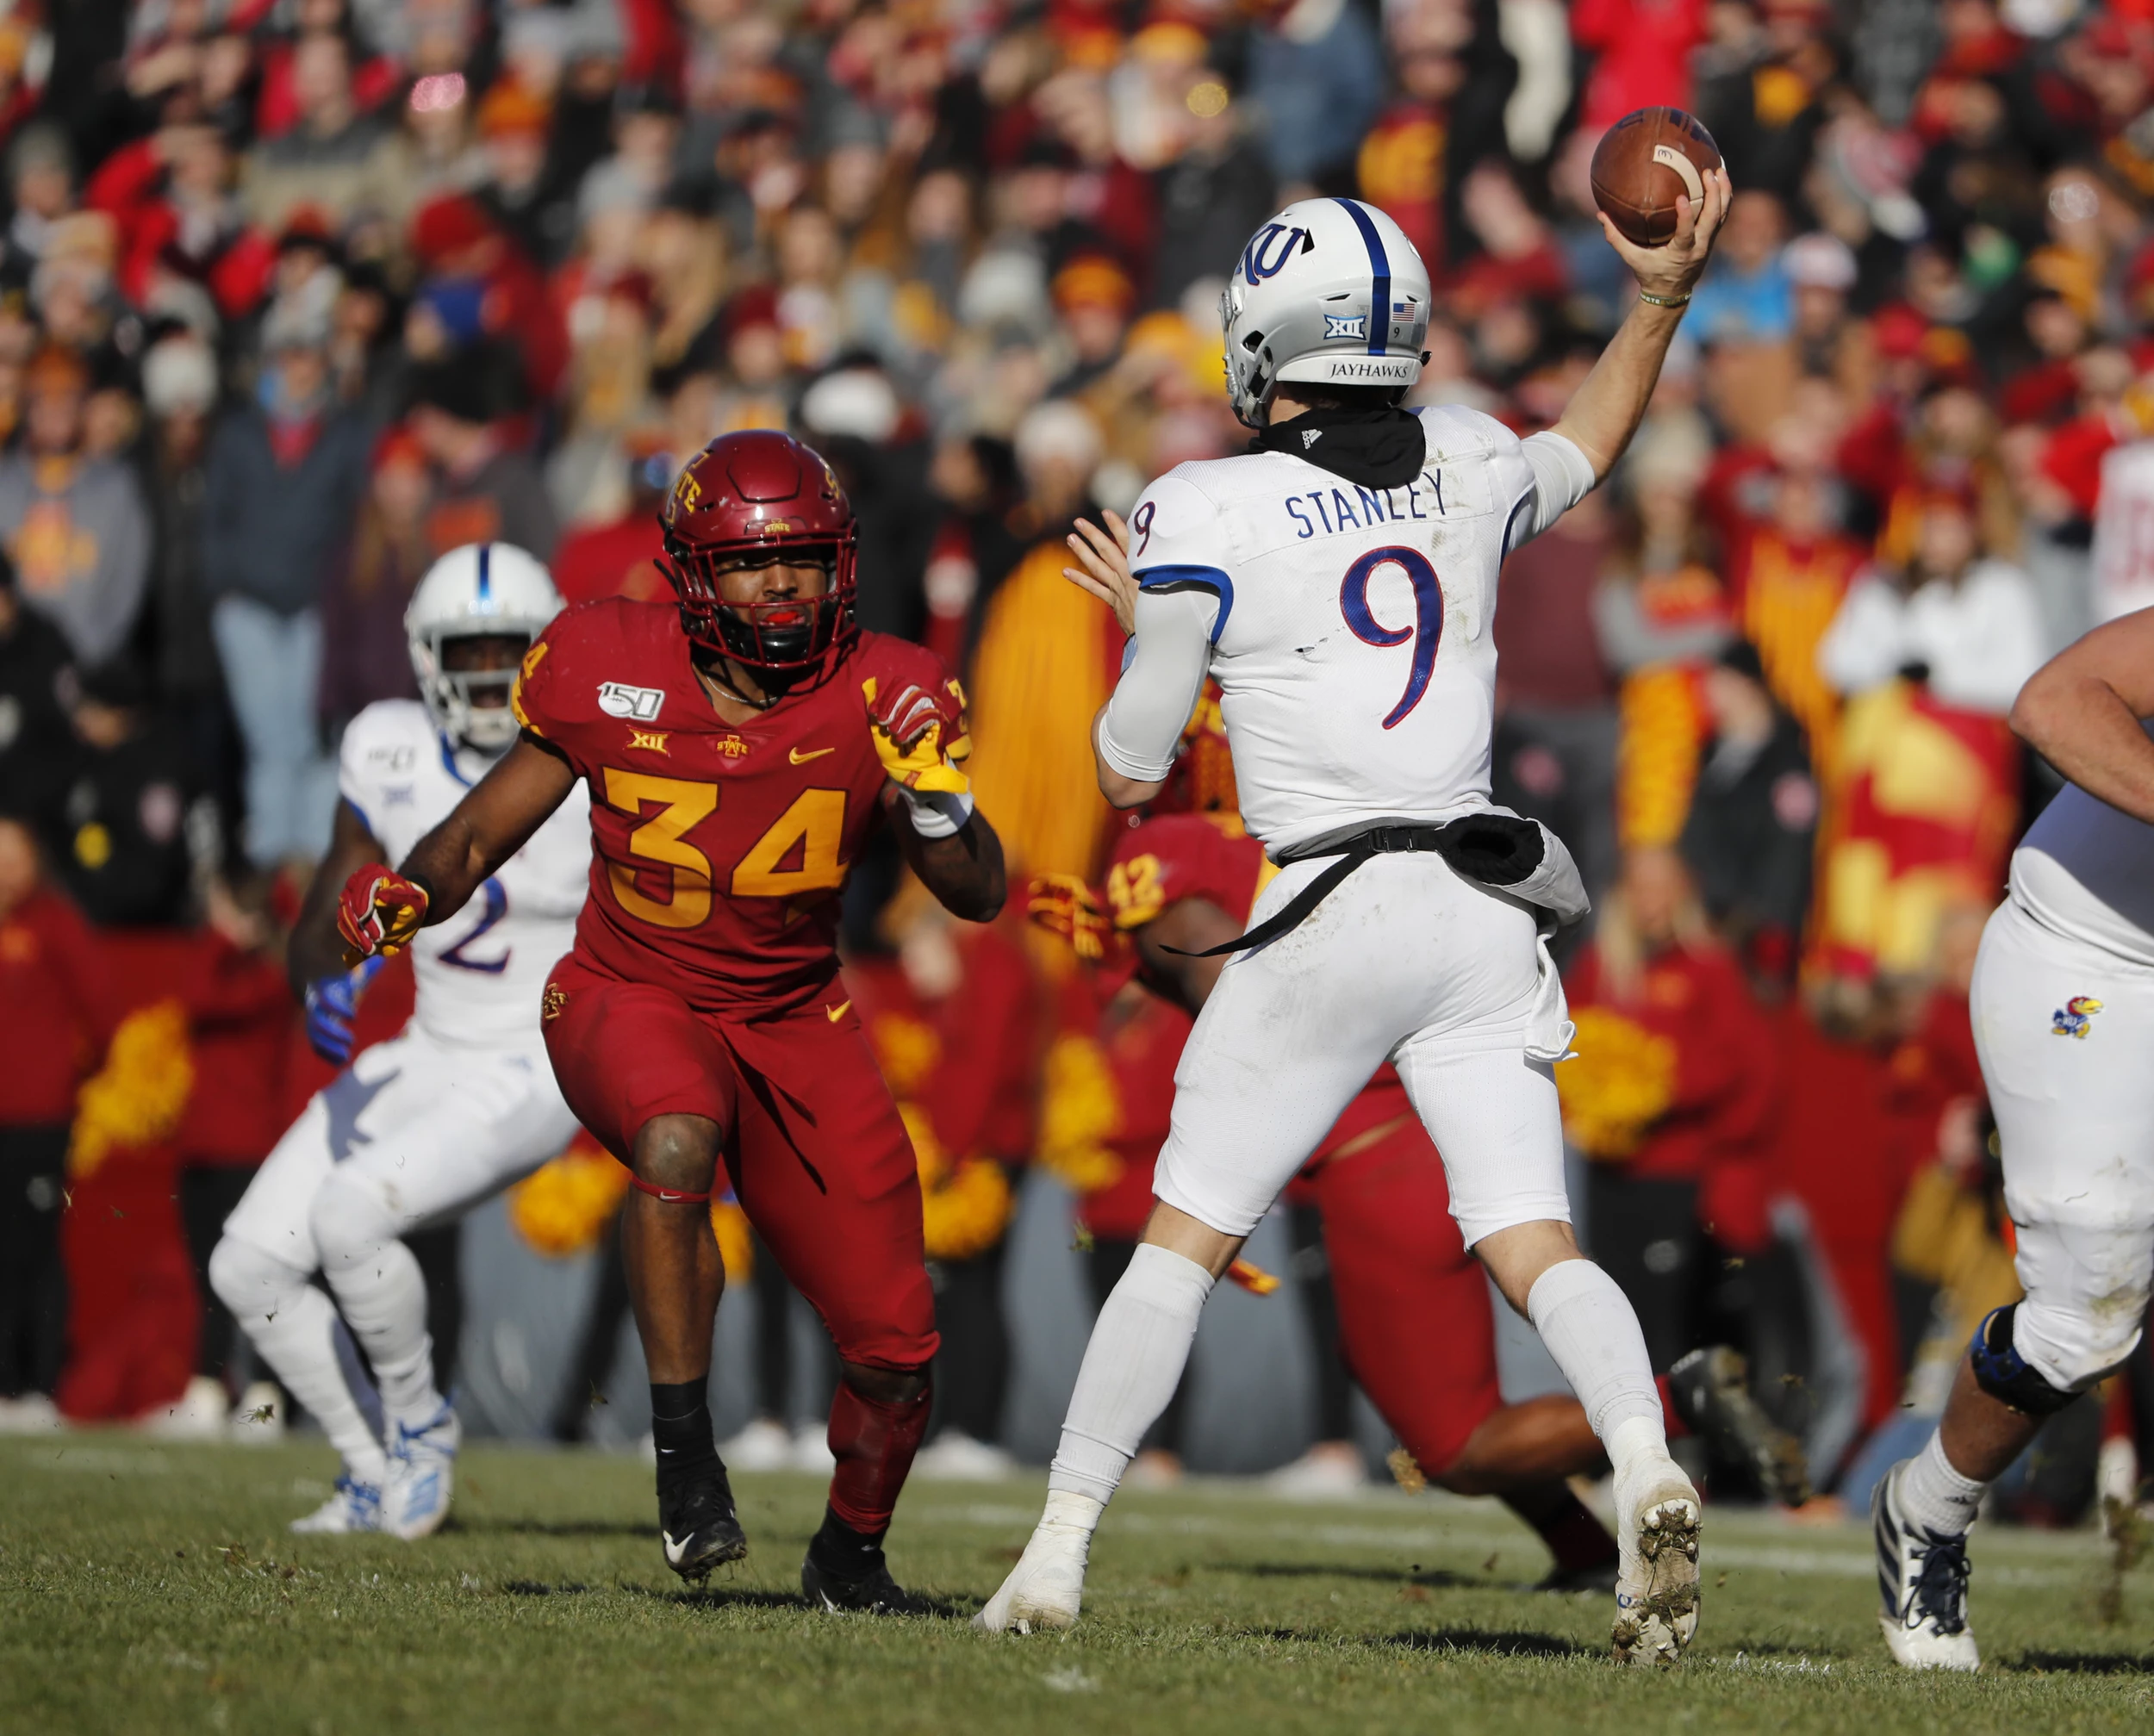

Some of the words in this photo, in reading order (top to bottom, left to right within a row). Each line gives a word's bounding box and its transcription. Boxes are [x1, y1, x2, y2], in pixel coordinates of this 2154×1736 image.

[1236, 223, 1305, 286] KU
[1323, 314, 1366, 340] XII
[1393, 327, 1400, 339] 9
[1329, 363, 1409, 379] JAYHAWKS
[1134, 501, 1156, 558] 9
[1285, 468, 1446, 538] STANLEY
[1339, 545, 1445, 731] 9
[596, 681, 665, 722] 150
[626, 728, 669, 755] XII
[602, 766, 850, 929] 34
[438, 875, 512, 974] 2
